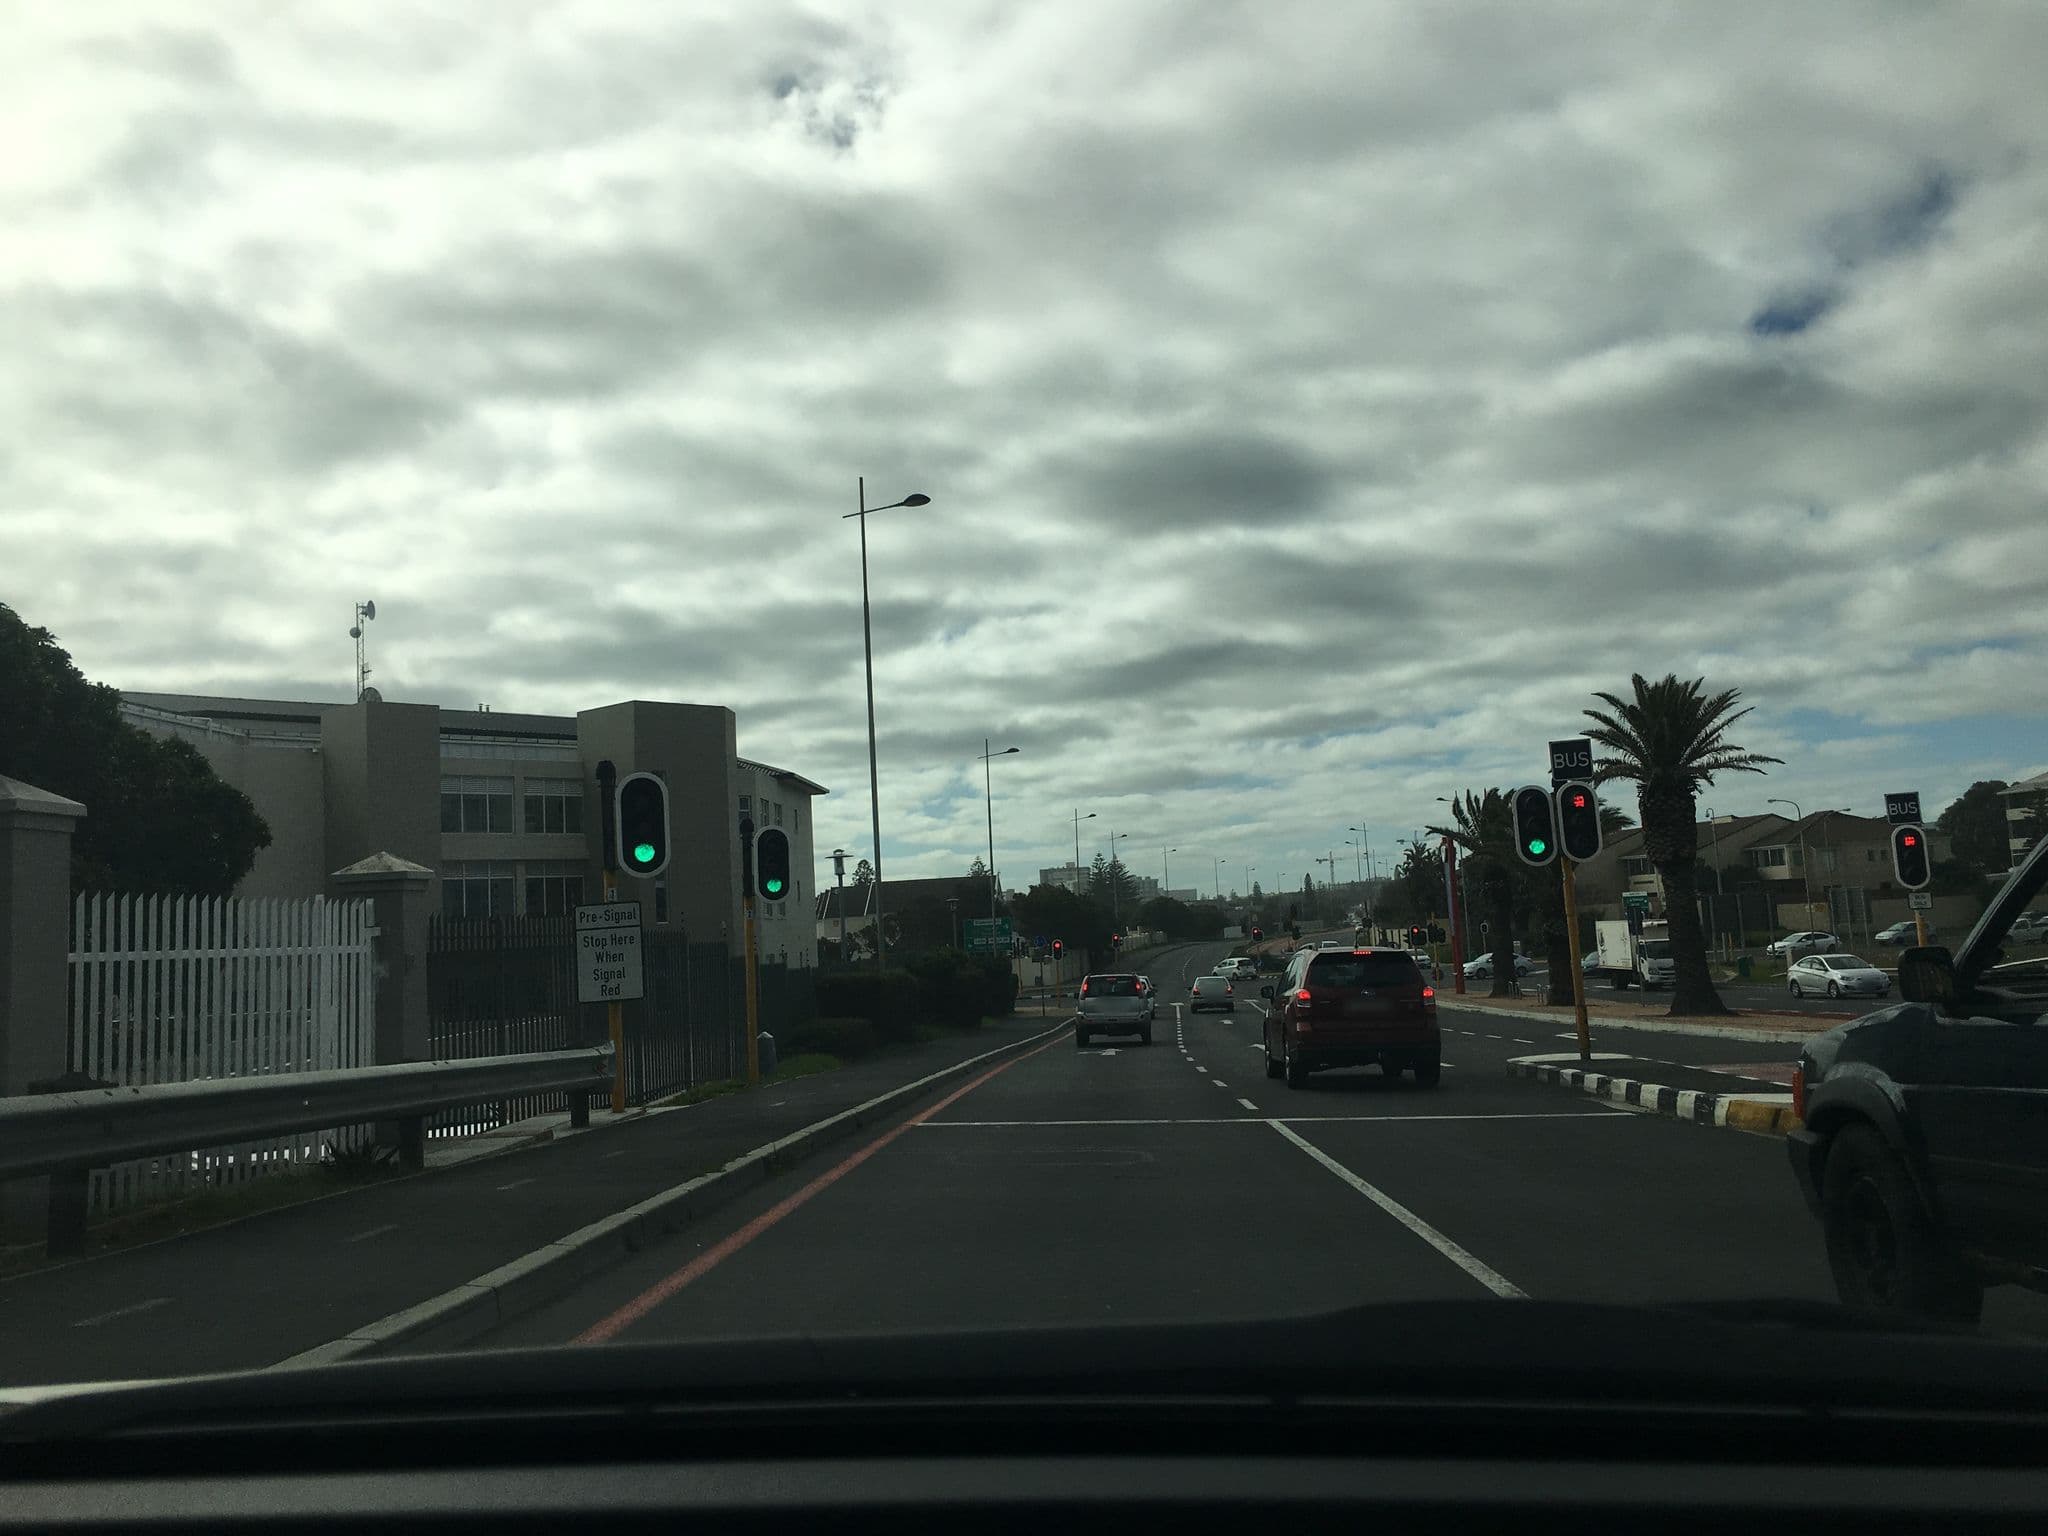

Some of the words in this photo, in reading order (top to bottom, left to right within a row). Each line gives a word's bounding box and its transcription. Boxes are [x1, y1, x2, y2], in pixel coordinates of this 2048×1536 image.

[1553, 751, 1590, 769] BUS
[1888, 801, 1918, 816] BUS
[583, 935, 608, 950] Stop
[610, 934, 635, 946] Here
[595, 951, 625, 964] When
[593, 966, 626, 983] Signal
[600, 983, 621, 996] Red
